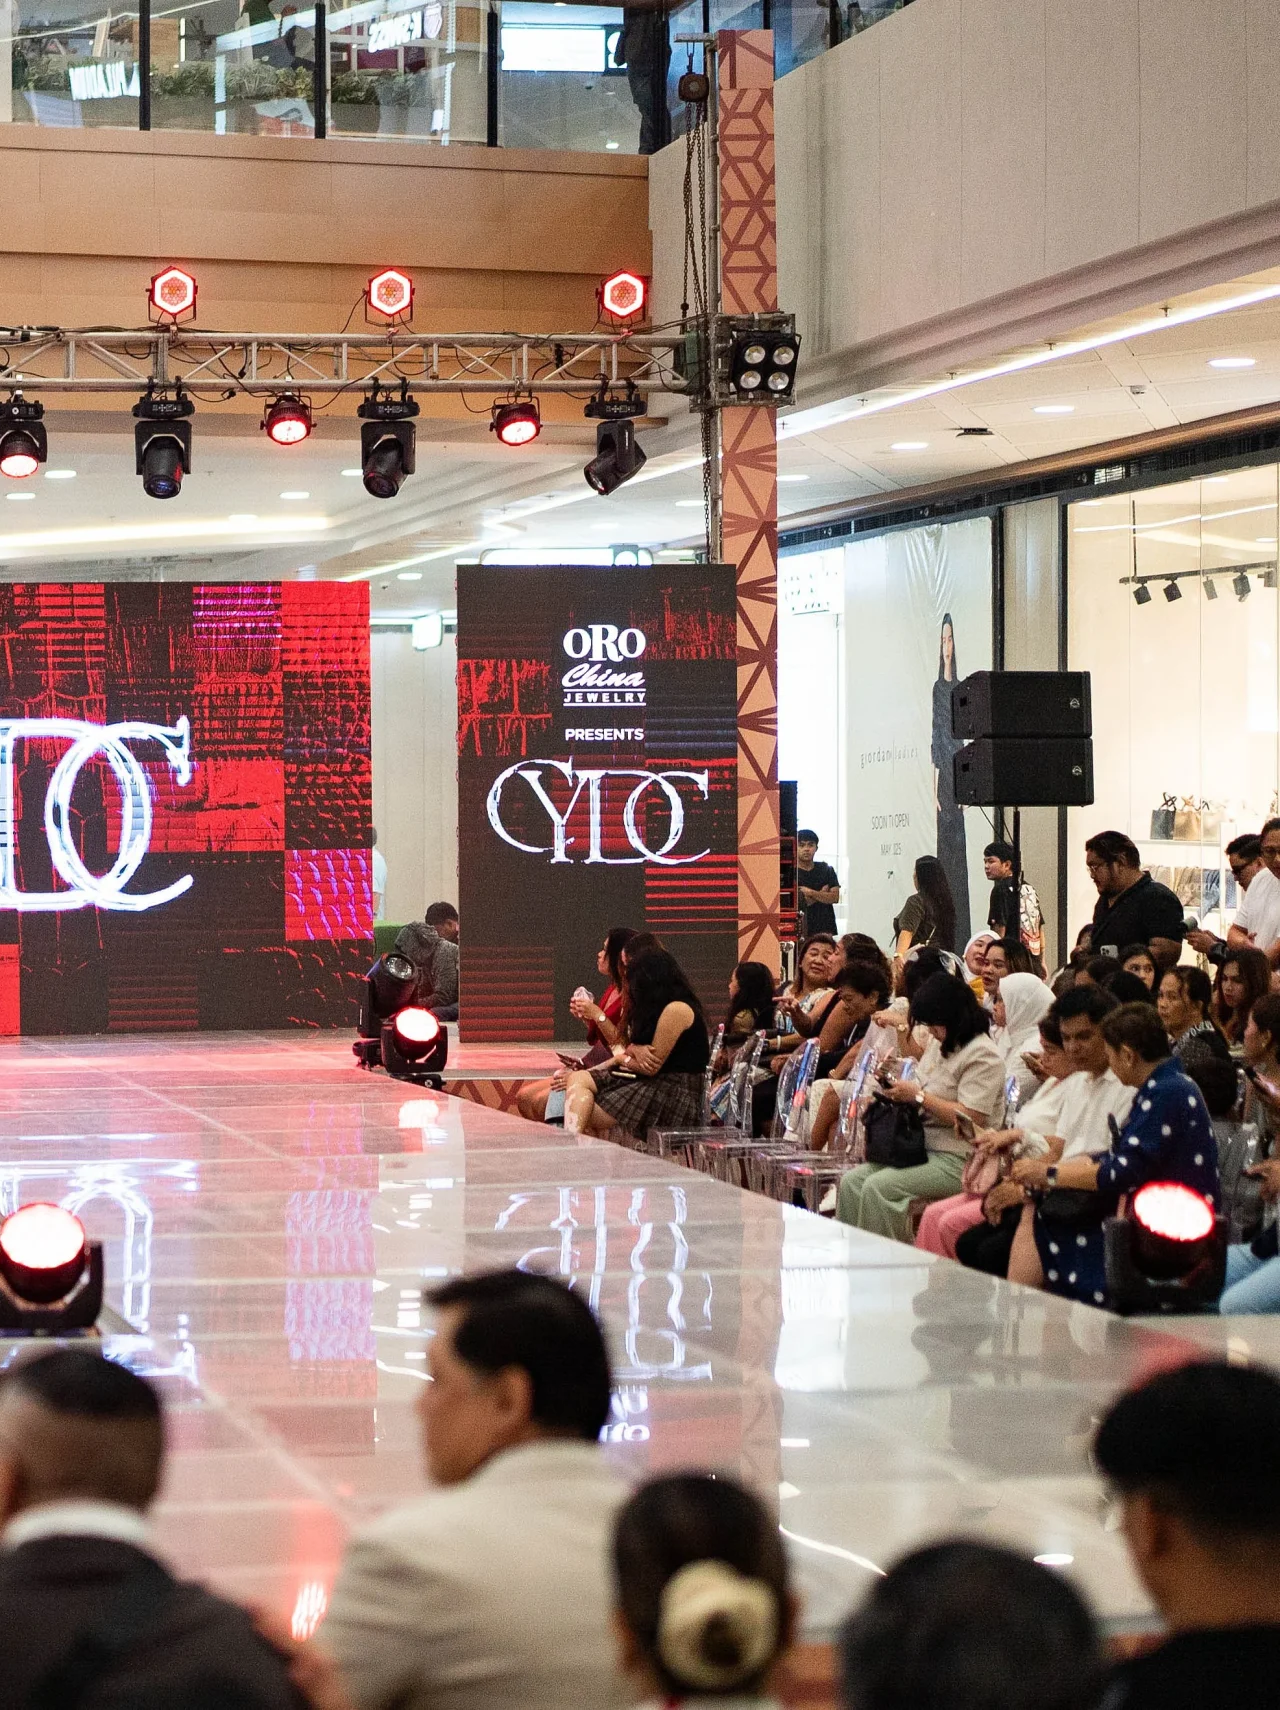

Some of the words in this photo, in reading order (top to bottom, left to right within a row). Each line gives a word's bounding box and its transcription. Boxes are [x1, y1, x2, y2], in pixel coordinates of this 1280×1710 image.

[561, 663, 645, 688] China
[563, 692, 646, 703] JEWELRY
[565, 728, 645, 741] PRESENTS
[871, 815, 888, 830] SOON
[894, 813, 910, 828] OPEN
